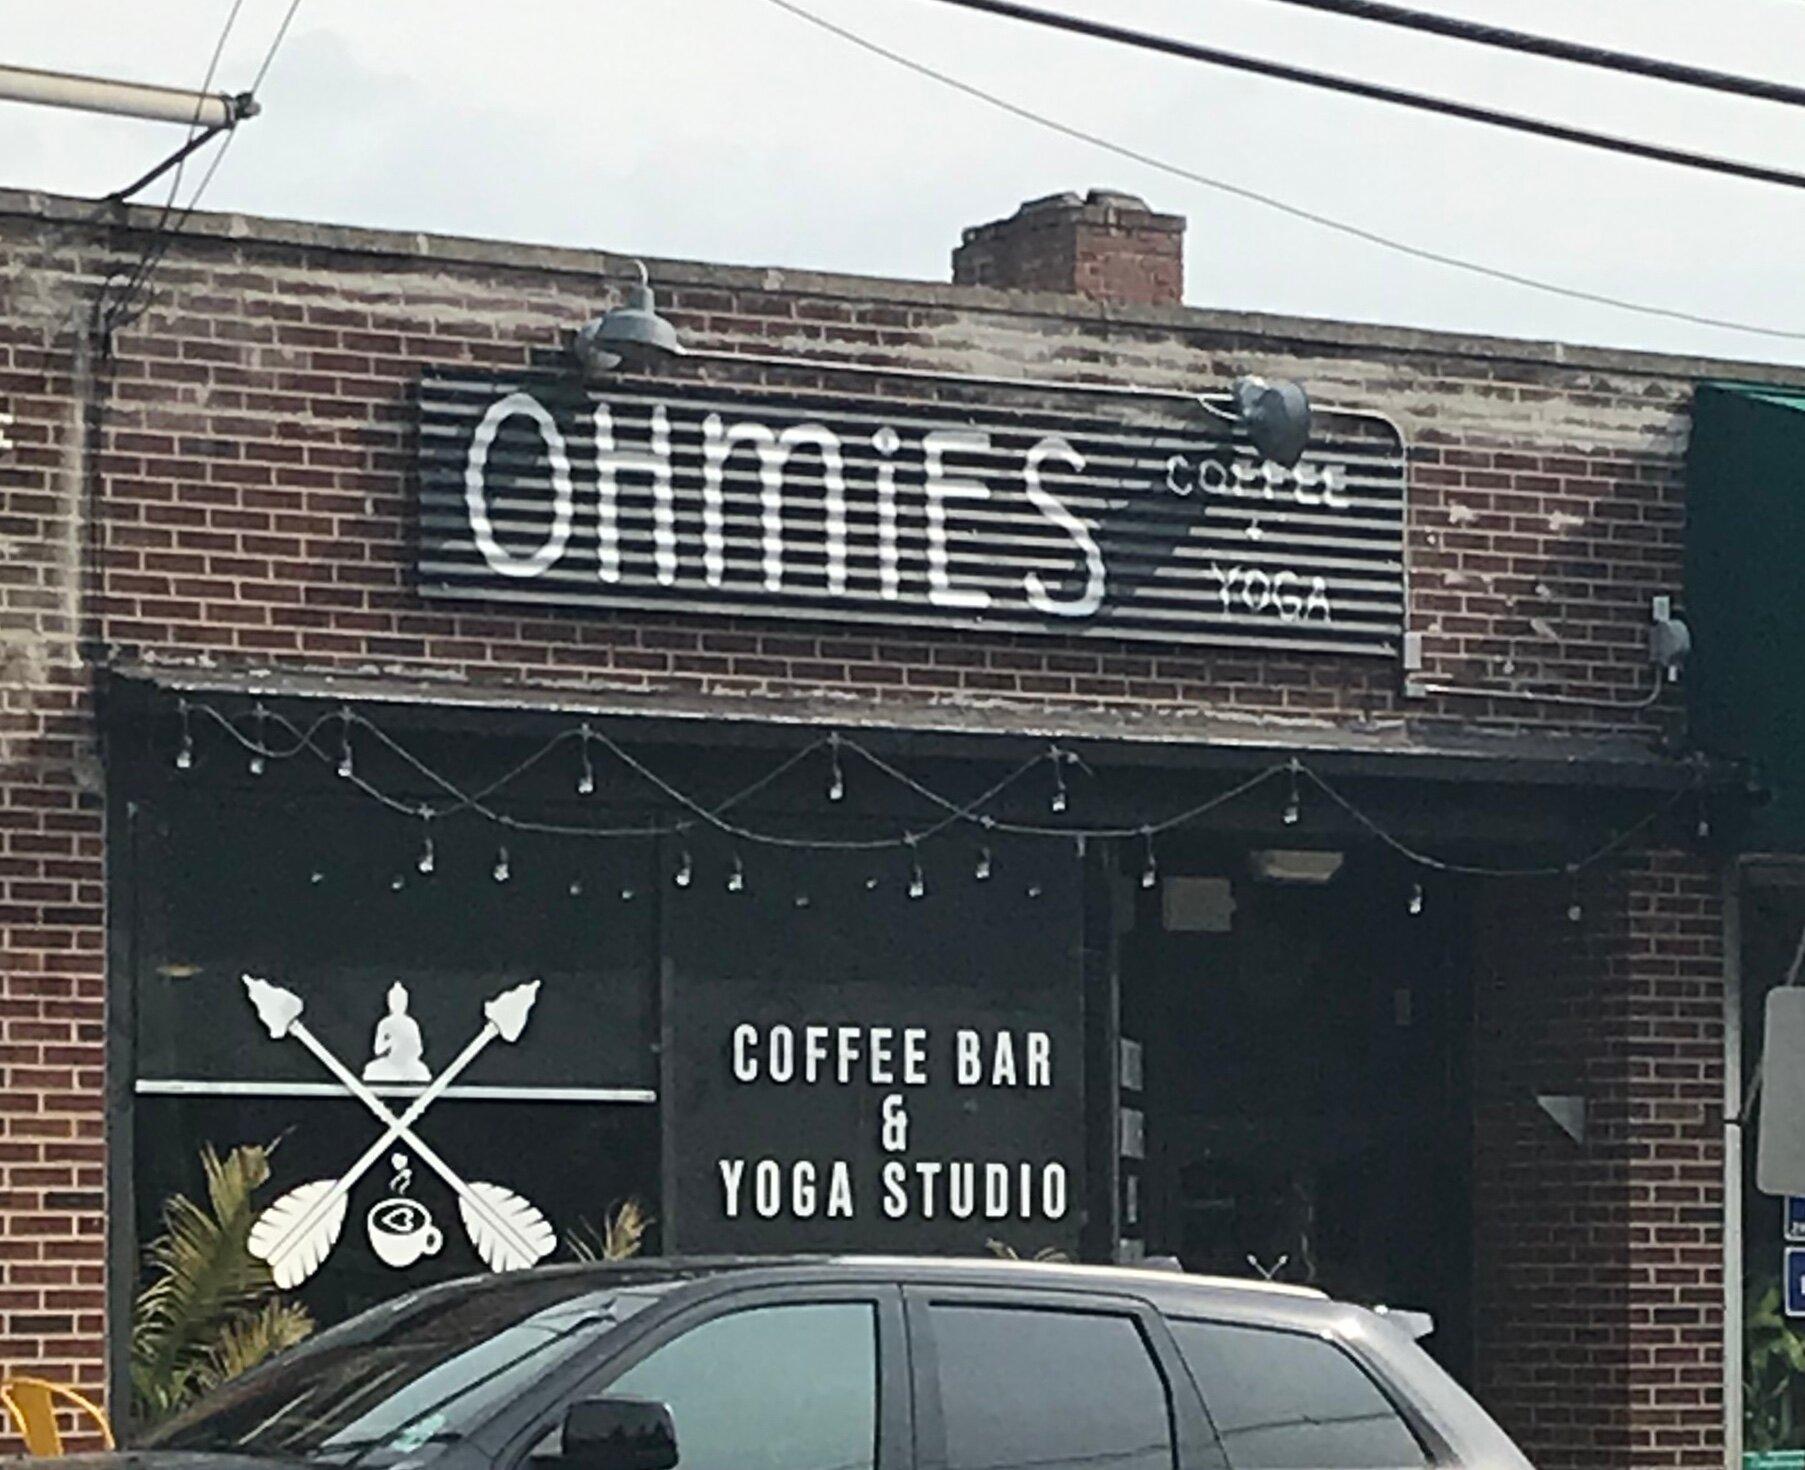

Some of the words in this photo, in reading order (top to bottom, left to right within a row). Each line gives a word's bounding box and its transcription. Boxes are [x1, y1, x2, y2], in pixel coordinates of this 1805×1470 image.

[1166, 454, 1350, 508] COFFEE
[1211, 562, 1331, 623] YOGA
[732, 1024, 927, 1085] COFFEE
[956, 1029, 1052, 1087] BAR
[881, 1094, 909, 1152] &
[719, 1159, 854, 1217] YOGA
[882, 1161, 1068, 1220] STUDIO
